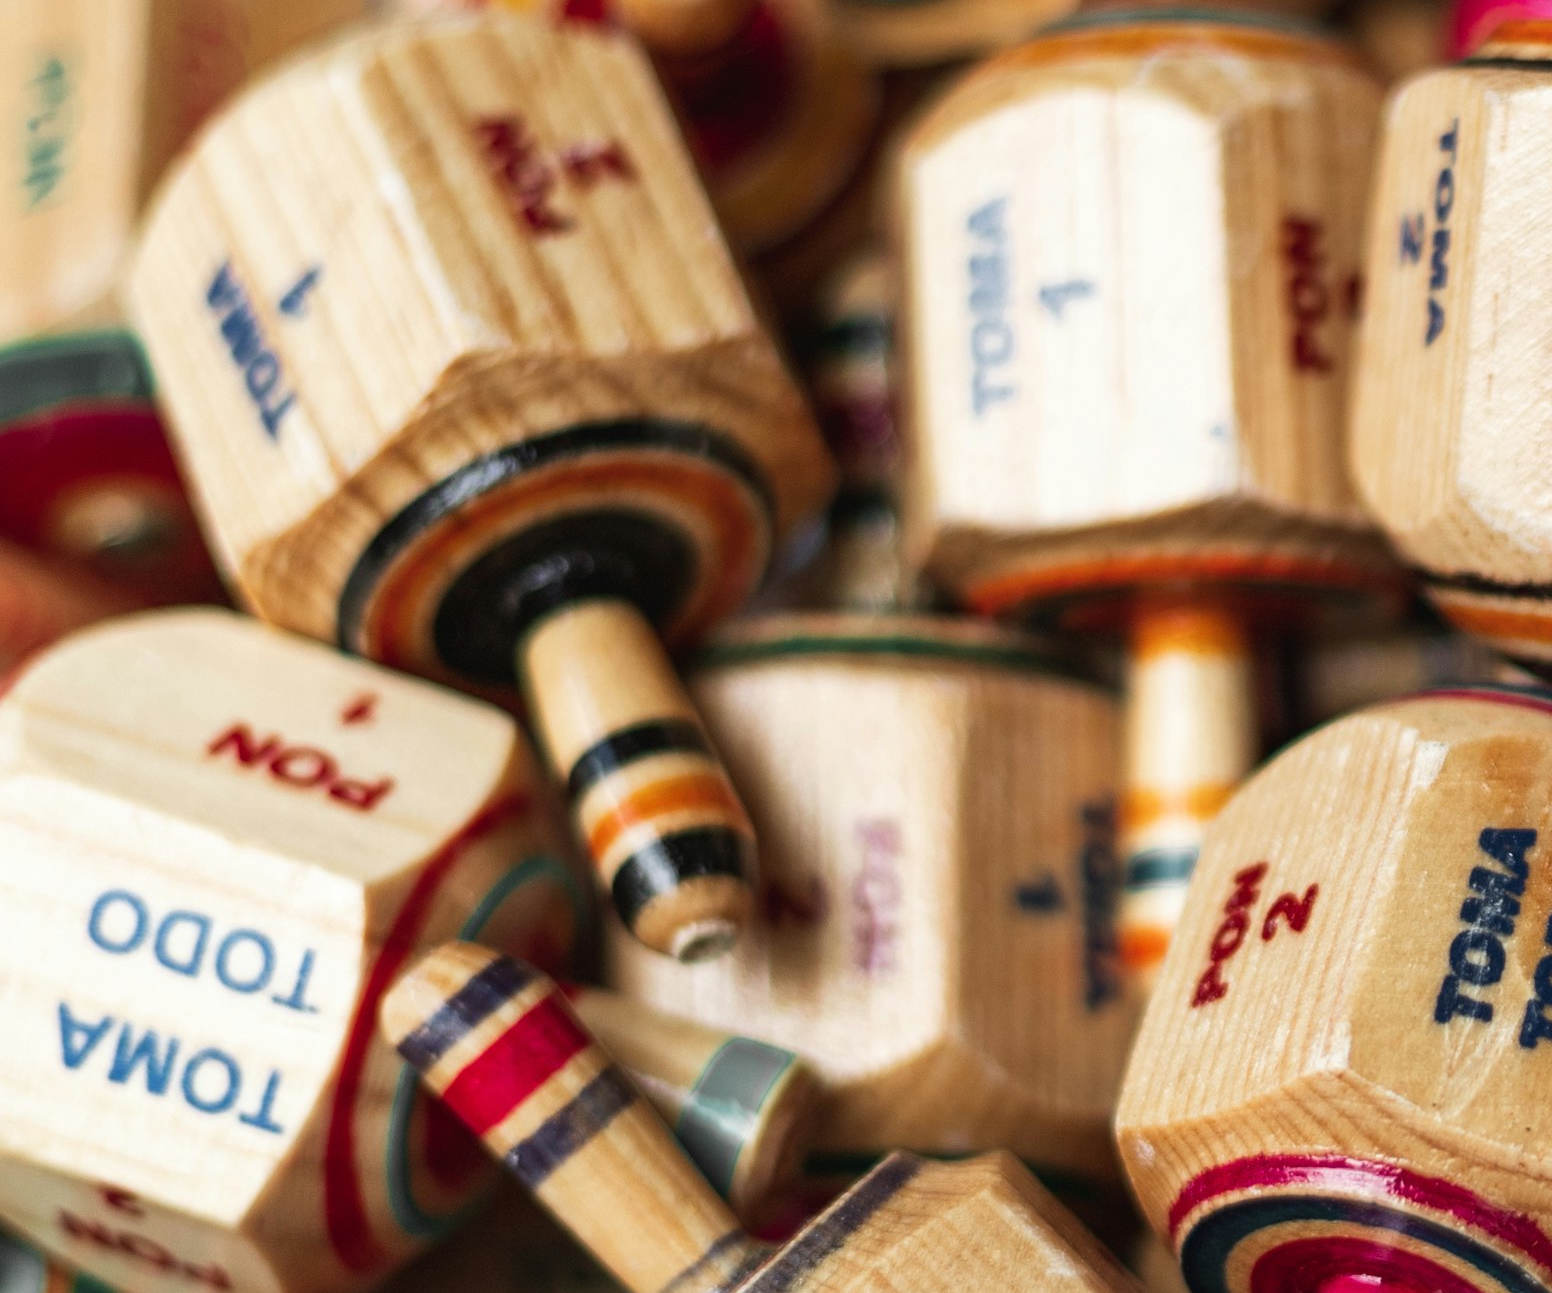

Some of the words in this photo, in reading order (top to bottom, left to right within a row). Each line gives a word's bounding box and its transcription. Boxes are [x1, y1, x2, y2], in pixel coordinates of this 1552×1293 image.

[278, 263, 323, 316] 1
[1425, 116, 1459, 347] TOMA
[206, 255, 297, 444] TOMA
[964, 193, 1016, 417] TOMA
[1039, 279, 1096, 322] 1
[206, 721, 397, 814] PON
[86, 888, 319, 1015] TODO
[1192, 860, 1269, 1009] PON
[1261, 882, 1320, 942] 2
[1433, 826, 1538, 1025] TOMA
[57, 1001, 284, 1136] TOMA
